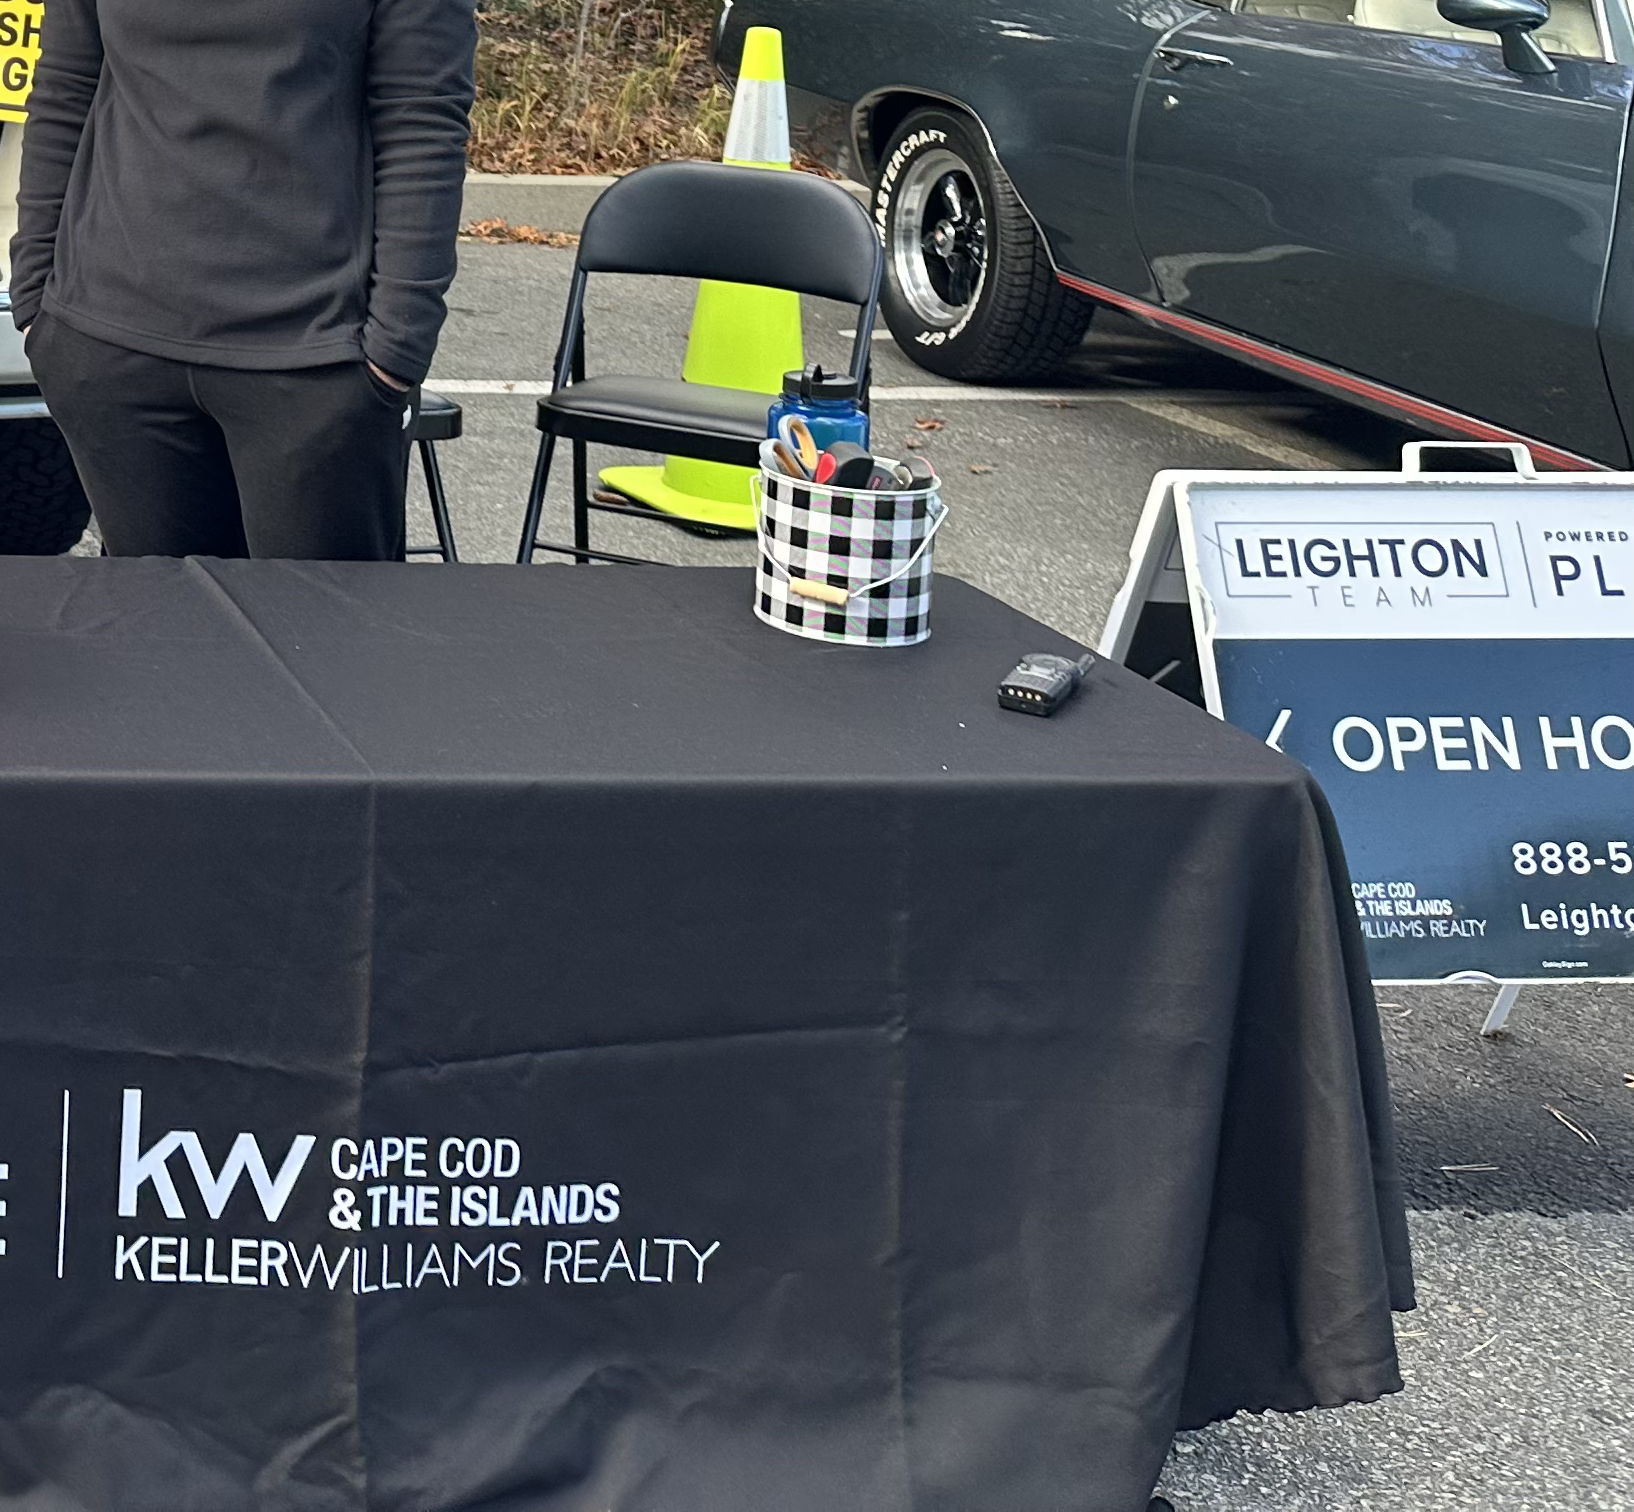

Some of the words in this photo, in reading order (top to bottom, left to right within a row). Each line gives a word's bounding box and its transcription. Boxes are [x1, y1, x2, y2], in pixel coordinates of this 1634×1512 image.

[874, 129, 948, 248] MASTERCRAFT
[1543, 530, 1629, 543] POWERED
[1234, 537, 1490, 579] LEIGHTON
[1549, 554, 1626, 597] PL
[1306, 585, 1433, 608] TEAM
[1332, 715, 1522, 772] OPEN
[1538, 714, 1634, 771] HO
[1511, 841, 1634, 876] 888-5
[1351, 882, 1386, 899] CAPE
[1387, 882, 1416, 898] COD
[1366, 899, 1394, 917] THE
[1394, 898, 1453, 916] ISLANDS
[1360, 919, 1426, 939] ILLIAMS
[1429, 919, 1487, 938] REALTY
[1521, 902, 1634, 936] Leighto
[118, 1088, 317, 1223] kw
[330, 1137, 428, 1182] CAPE
[439, 1136, 521, 1179] COD
[328, 1187, 362, 1231] &
[366, 1185, 440, 1228] THE
[449, 1182, 621, 1227] ISLANDS
[544, 1238, 721, 1285] REALTY
